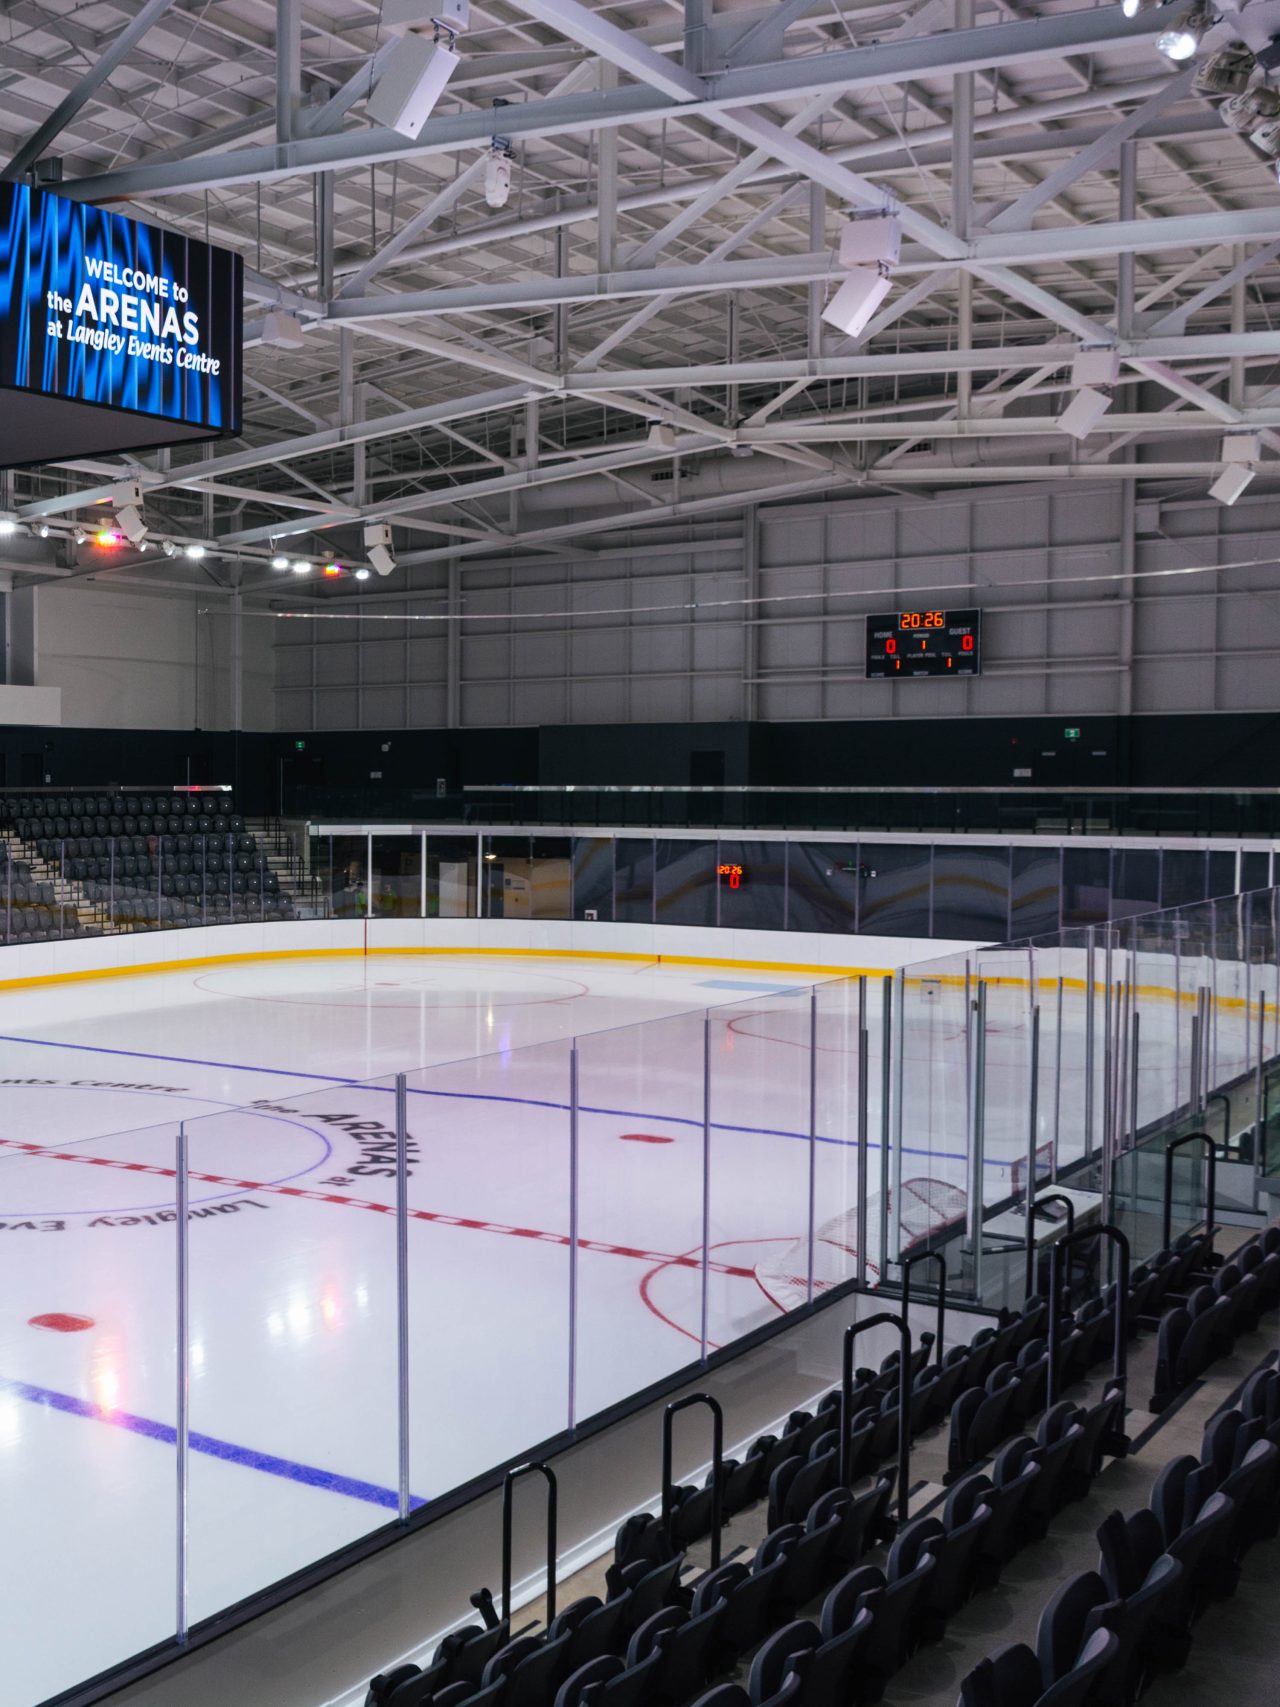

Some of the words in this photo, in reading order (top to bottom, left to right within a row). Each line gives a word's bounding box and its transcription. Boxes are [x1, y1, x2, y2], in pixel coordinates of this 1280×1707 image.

[85, 255, 169, 298] WELCOME
[172, 281, 189, 303] to
[47, 290, 73, 313] the
[75, 282, 200, 345] ARENAS
[47, 320, 63, 338] at
[66, 319, 125, 356] Langley
[127, 335, 173, 365] Events
[176, 347, 221, 376] Centre
[901, 612, 944, 628] 20:26
[885, 639, 896, 653] 0
[922, 640, 926, 650] 1
[962, 635, 973, 650] 0
[896, 660, 900, 670] 1
[947, 657, 952, 668] 1
[730, 874, 740, 888] 0
[70, 1080, 190, 1092] Centre
[300, 1114, 421, 1178] ARENAS
[88, 1199, 271, 1228] Langley
